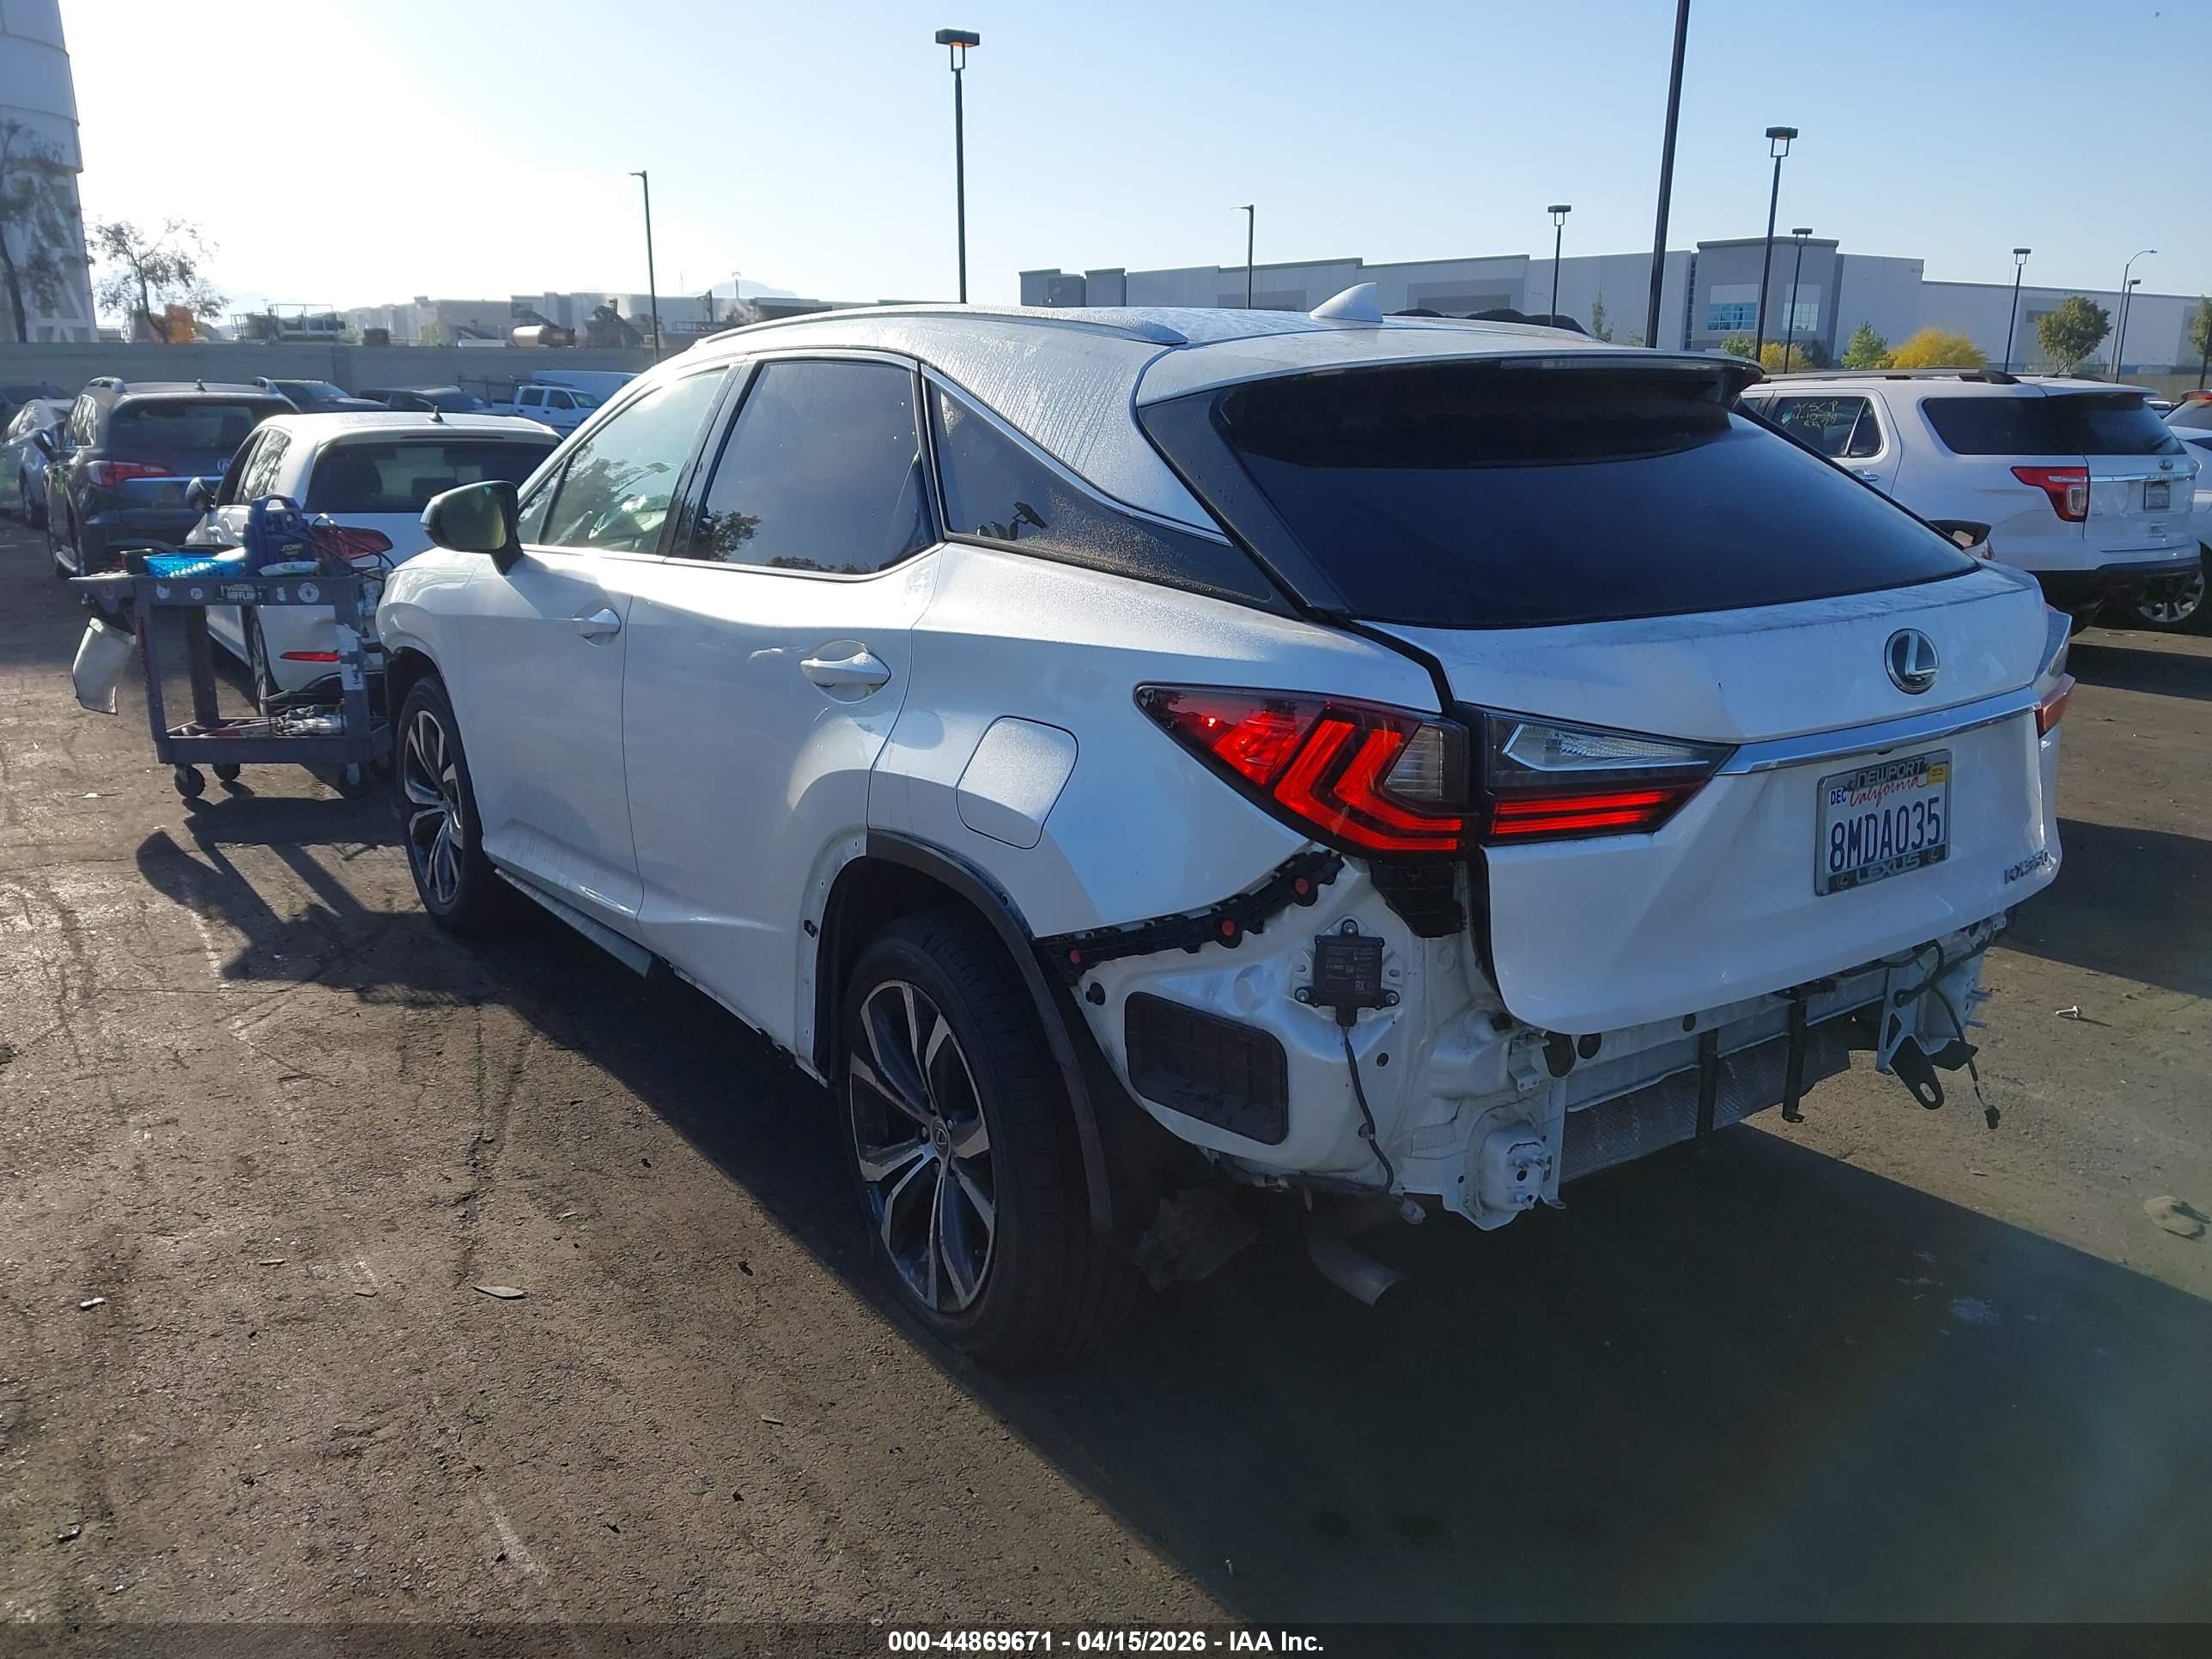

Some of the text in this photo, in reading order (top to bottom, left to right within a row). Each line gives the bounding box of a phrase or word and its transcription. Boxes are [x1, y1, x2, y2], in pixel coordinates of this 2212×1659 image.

[1856, 760, 1923, 788] NEWPORT
[1830, 787, 1847, 805] DEC
[1849, 775, 1927, 808] California
[1829, 796, 1940, 873] 8MDA035
[1856, 853, 1921, 884] LEXUS
